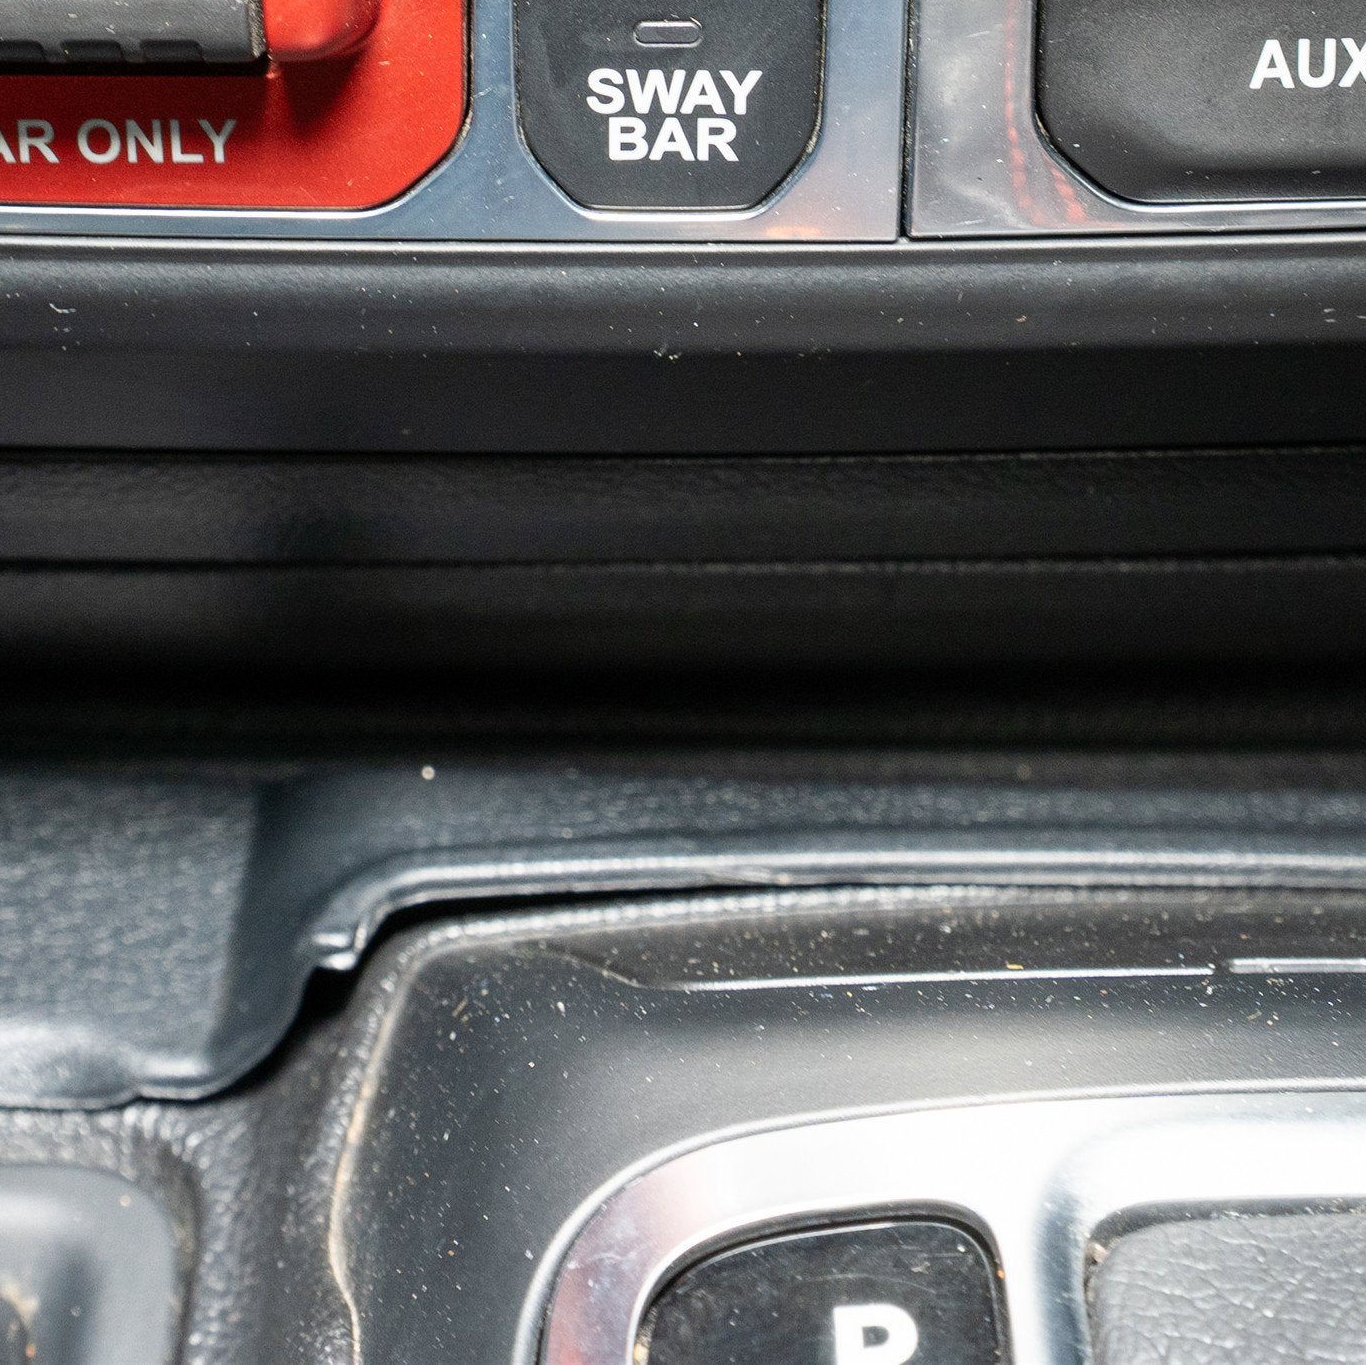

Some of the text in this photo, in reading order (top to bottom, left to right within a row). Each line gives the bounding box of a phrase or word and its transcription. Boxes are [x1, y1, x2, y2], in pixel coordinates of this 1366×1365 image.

[586, 68, 763, 115] SWAY
[76, 118, 238, 165] ONLY
[608, 116, 739, 162] BAR
